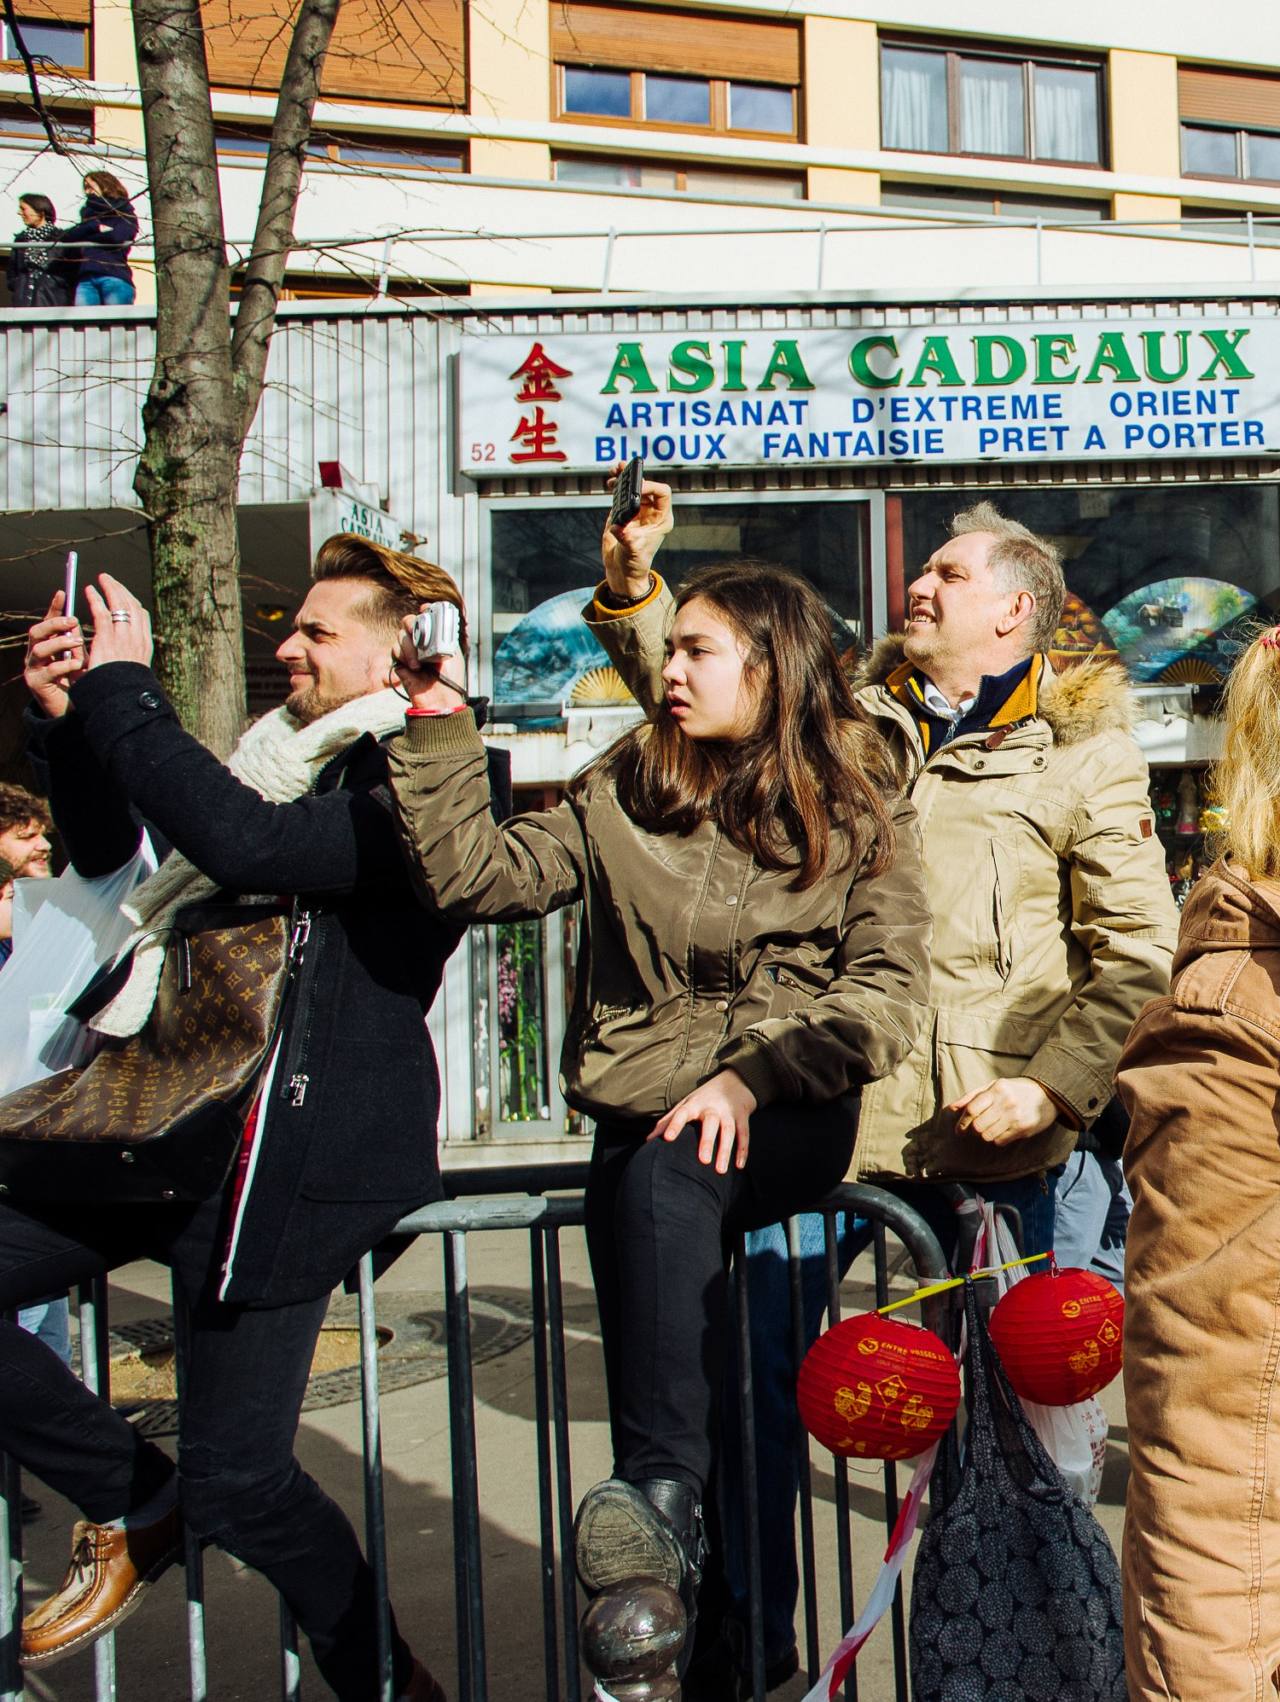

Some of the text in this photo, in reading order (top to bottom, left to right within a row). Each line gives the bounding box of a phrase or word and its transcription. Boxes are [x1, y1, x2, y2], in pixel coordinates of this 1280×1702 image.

[600, 328, 1256, 395] ASIA CADEAUX
[509, 342, 572, 463] 金生
[604, 388, 1241, 428] ARTISANAT D'EXTREME ORIENT
[471, 443, 496, 462] 52
[594, 419, 1266, 463] BIJOUX FANTAISIE PRET A PORTER
[352, 503, 383, 533] ASIA
